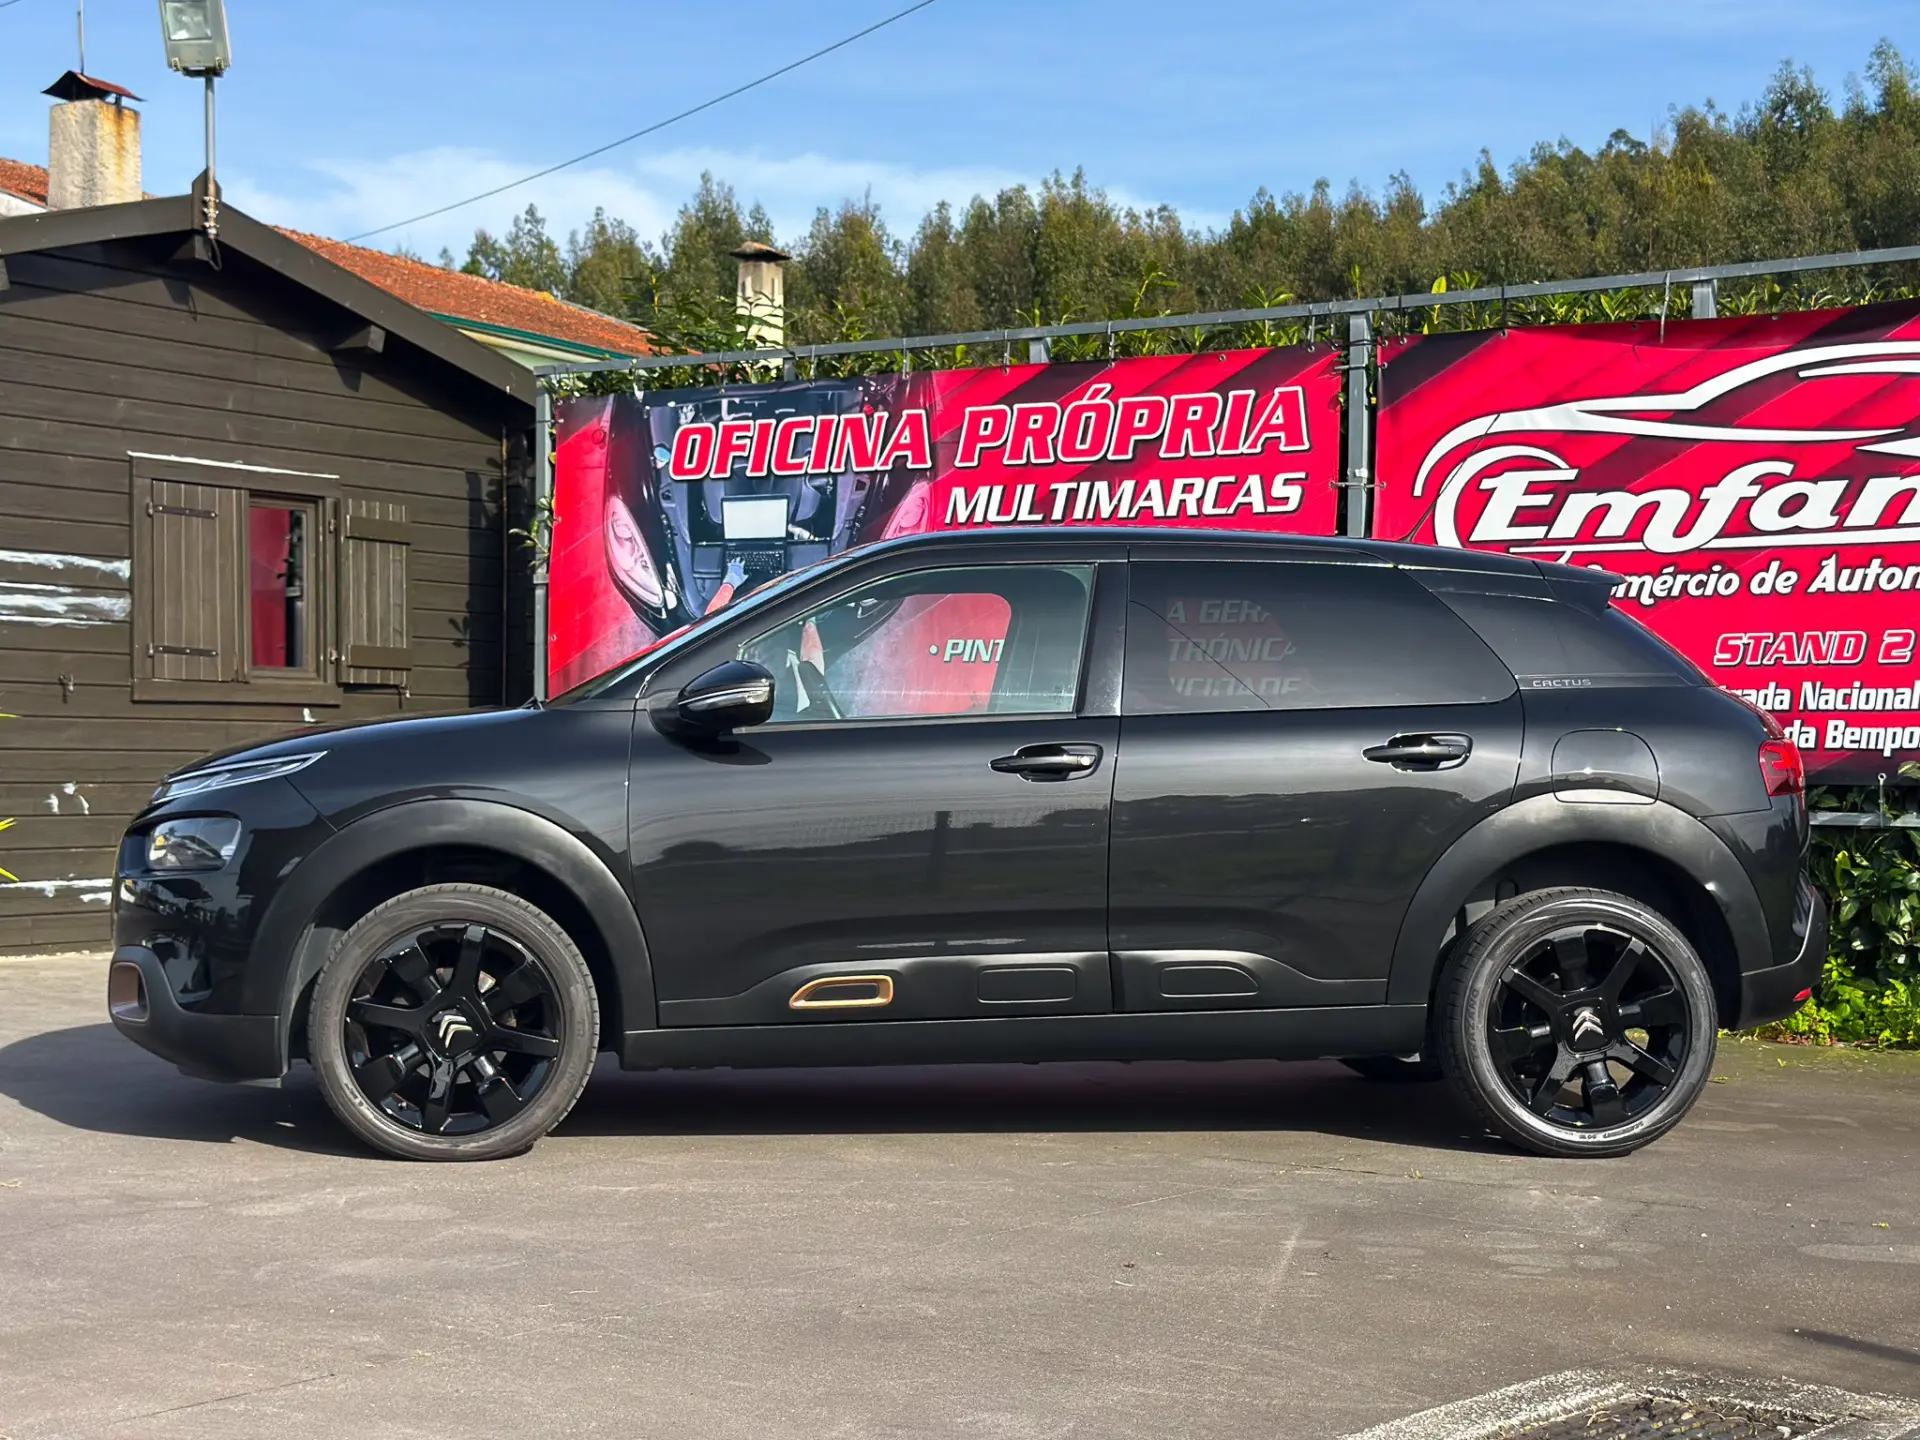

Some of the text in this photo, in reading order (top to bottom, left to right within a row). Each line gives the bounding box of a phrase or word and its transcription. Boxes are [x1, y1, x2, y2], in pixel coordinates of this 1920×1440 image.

[669, 383, 1310, 480] OFICINA PRÓPRIA
[945, 472, 1306, 524] MULTIMARCAS
[1587, 564, 1740, 606] mércio
[1750, 560, 1799, 595] de
[943, 639, 1006, 662] PINT
[1713, 629, 1915, 666] STAND 2
[1532, 678, 1592, 688] CACTUS
[1799, 680, 1920, 711] Nacional
[1783, 719, 1920, 758] da Bempo
